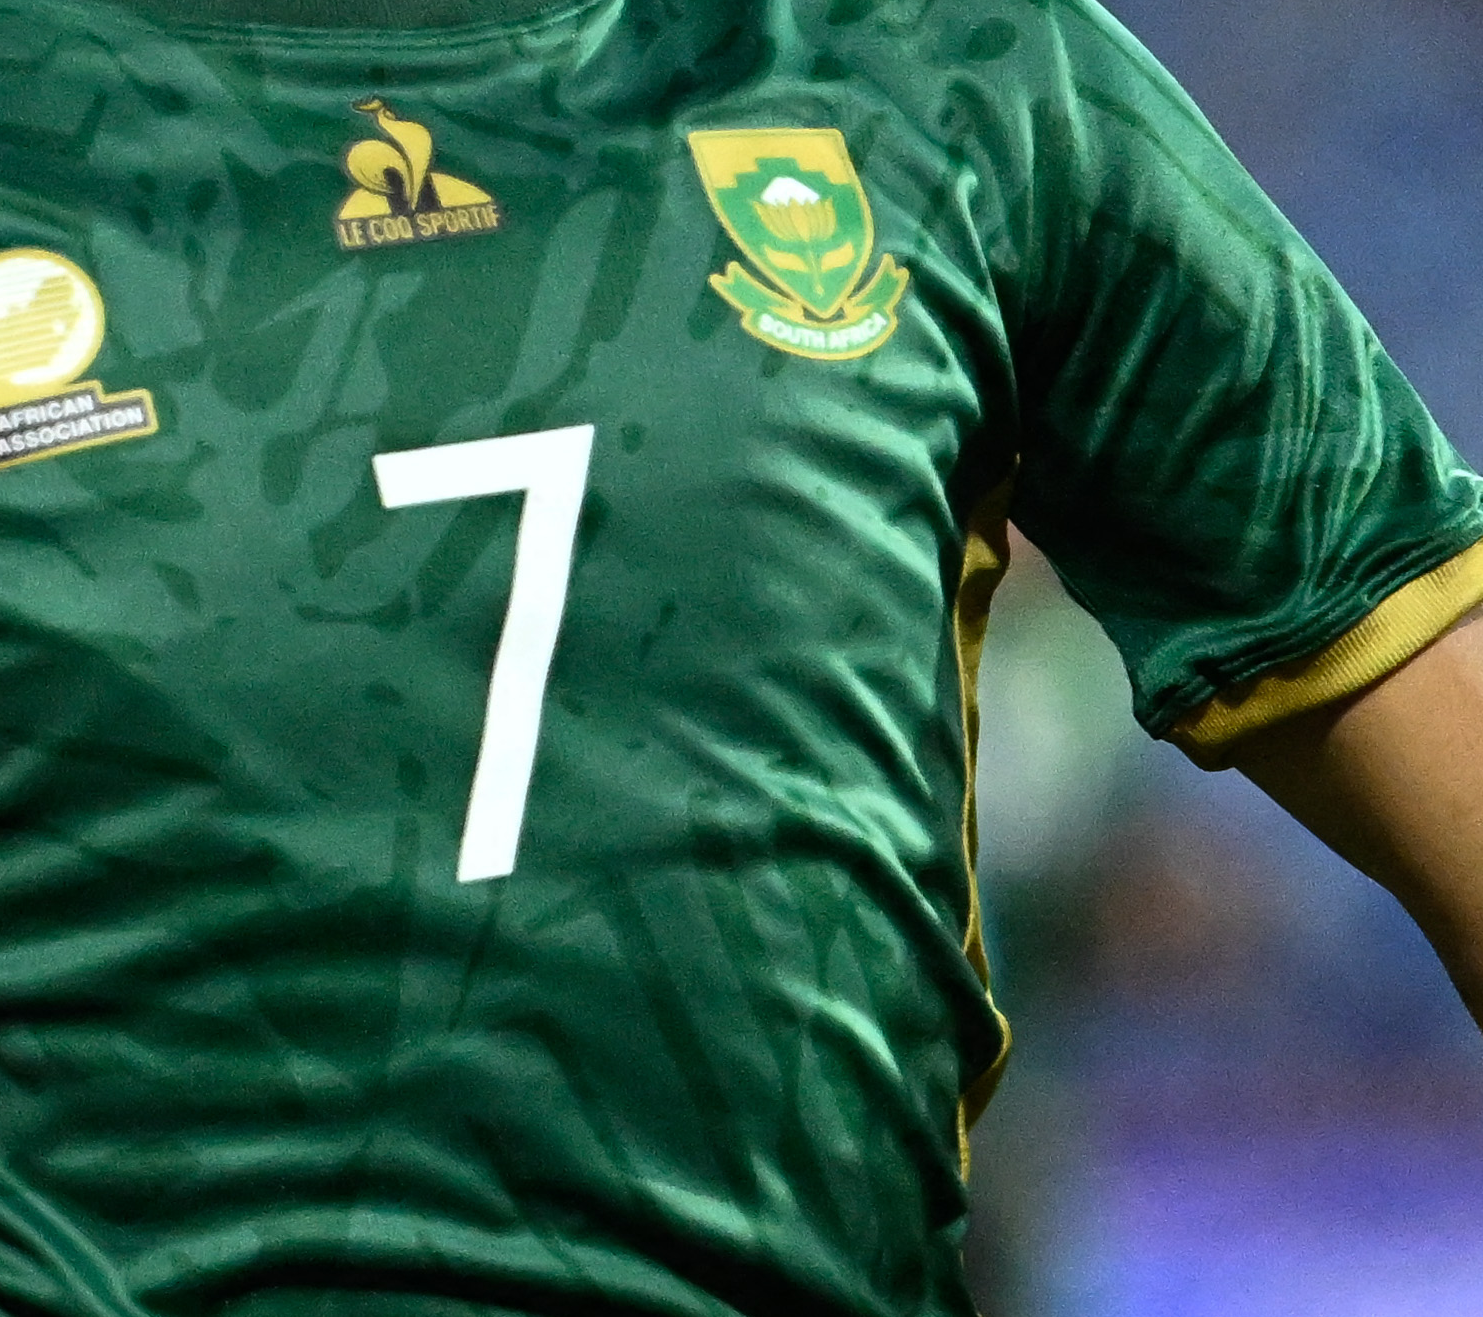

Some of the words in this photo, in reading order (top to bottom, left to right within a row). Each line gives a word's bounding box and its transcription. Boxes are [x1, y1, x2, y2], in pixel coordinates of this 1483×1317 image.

[338, 220, 366, 247] LE
[369, 215, 414, 246] COQ
[757, 312, 826, 349] SOUTH
[828, 311, 887, 349] AFRICA
[372, 423, 595, 883] 7
